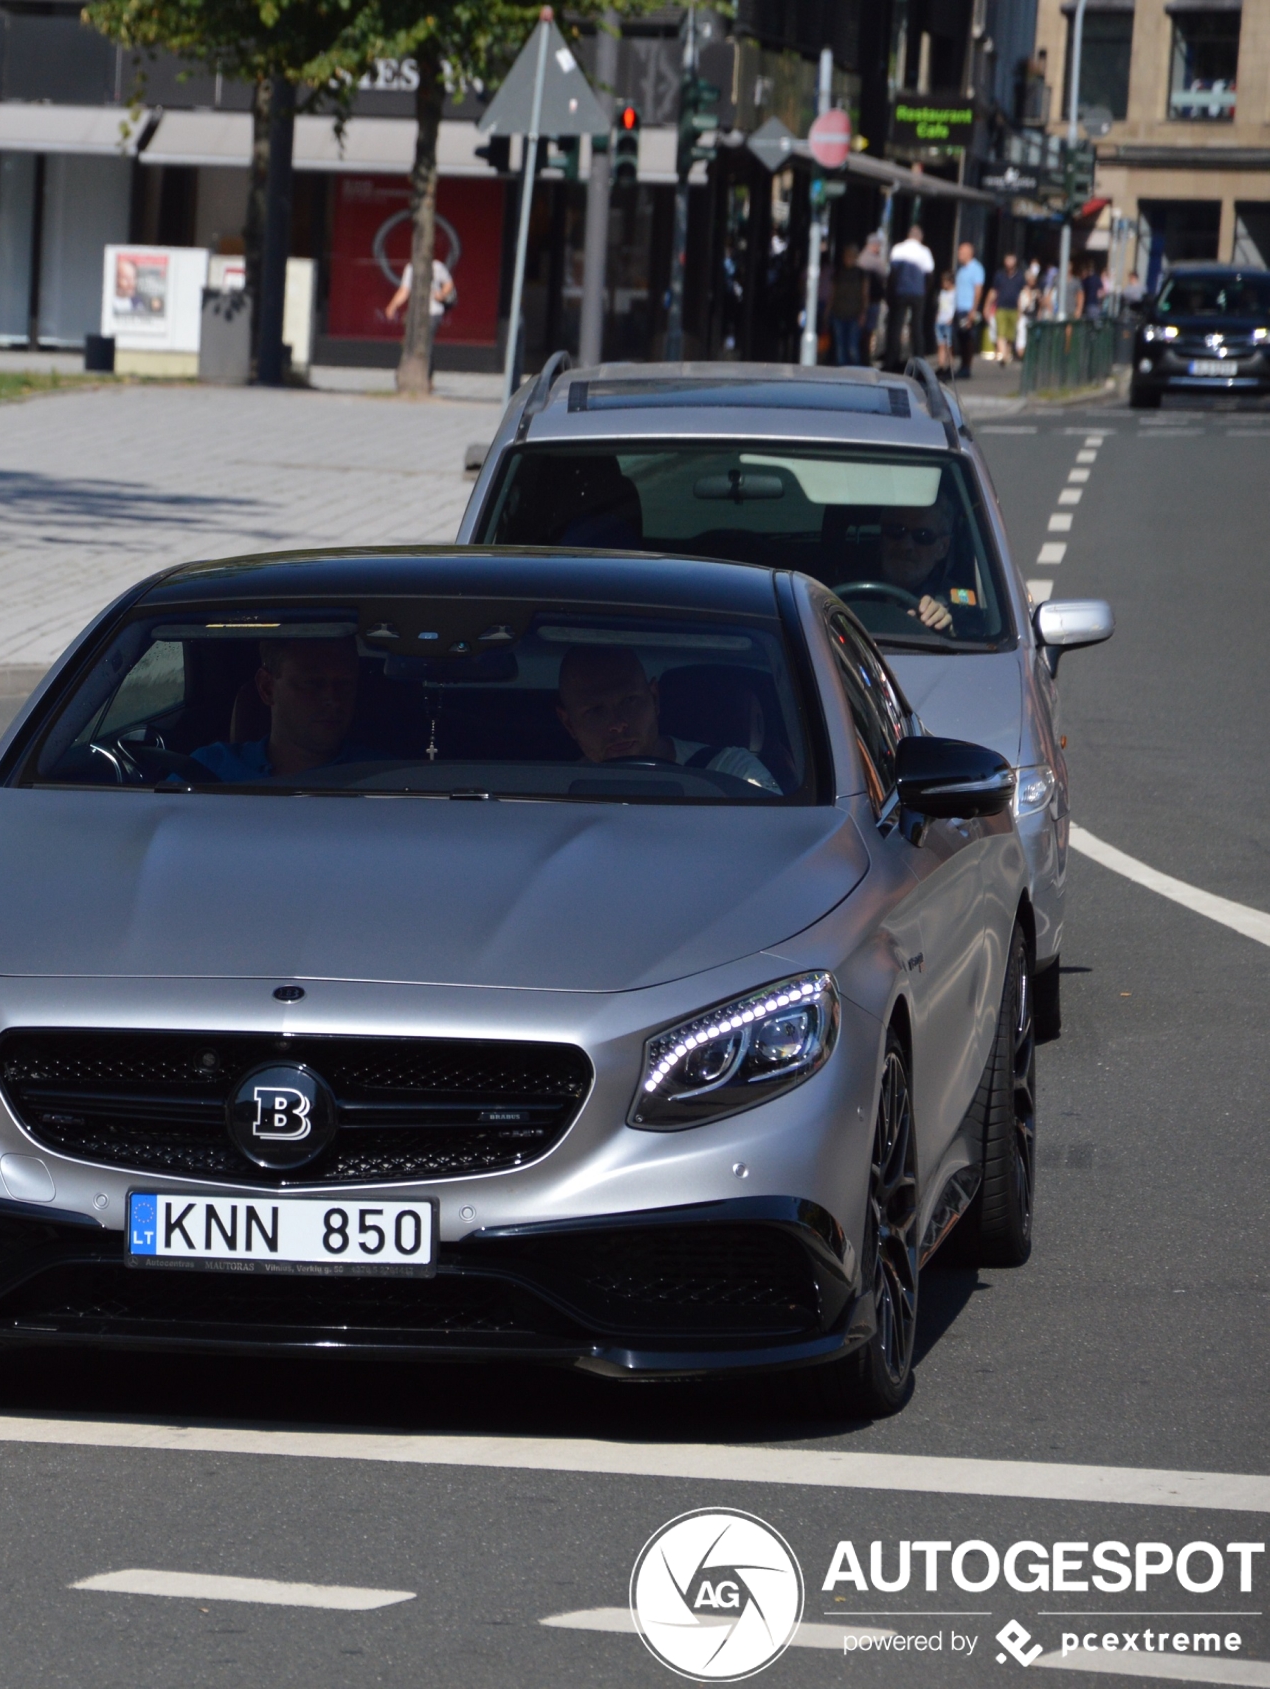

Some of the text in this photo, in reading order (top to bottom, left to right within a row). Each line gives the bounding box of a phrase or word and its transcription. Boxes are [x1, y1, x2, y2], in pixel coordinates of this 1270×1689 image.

[896, 105, 973, 124] Restaurant
[488, 1113, 522, 1121] BRABUS
[133, 1202, 422, 1256] LT KNN 850
[145, 1258, 195, 1268] Autocentras
[204, 1260, 255, 1271] MAUTORAS
